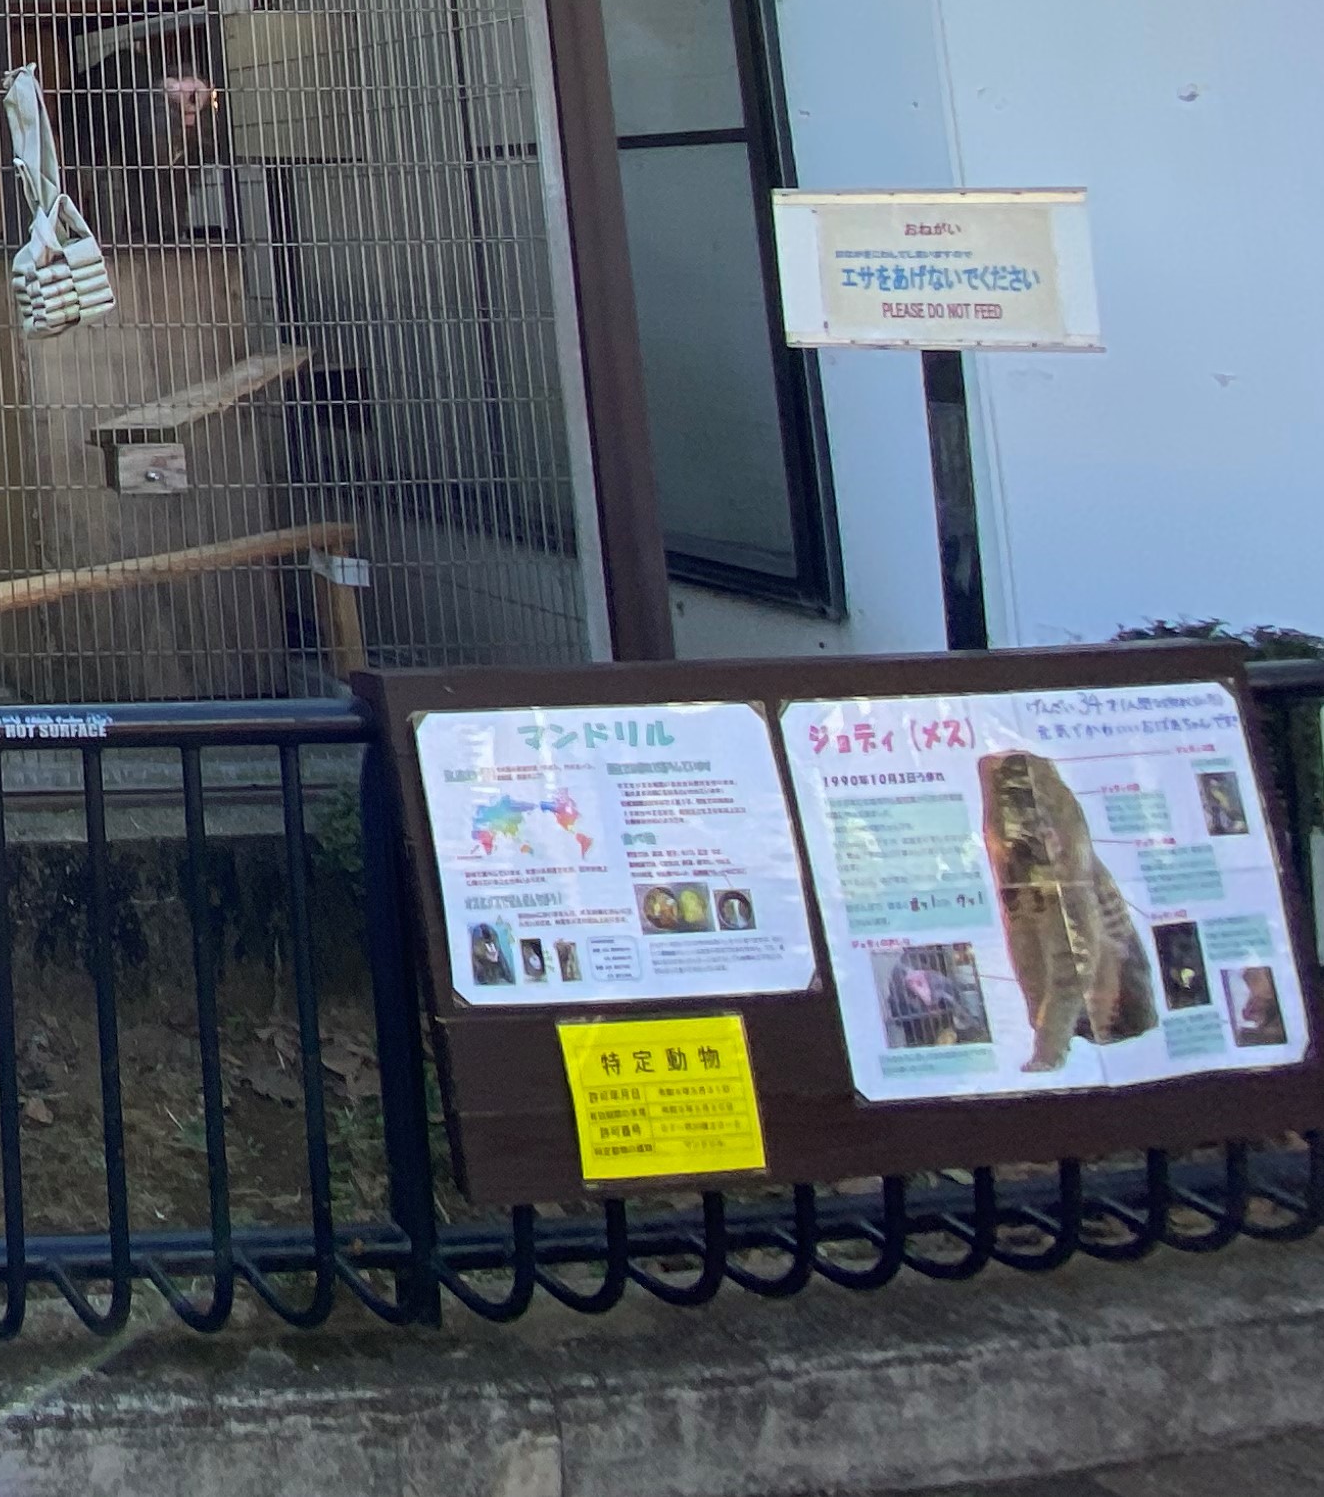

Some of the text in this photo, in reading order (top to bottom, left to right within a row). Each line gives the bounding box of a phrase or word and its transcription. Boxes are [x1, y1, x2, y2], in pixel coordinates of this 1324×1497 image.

[904, 222, 963, 237] おねがい
[840, 264, 1042, 292] エサをあげないでください
[881, 302, 1003, 319] PLEASE DO NOT FEED
[5, 723, 107, 739] HOT SURFACE
[516, 719, 676, 751] マンドリル
[600, 1045, 721, 1077] 特定動物
[588, 1088, 641, 1104] 許可年月日
[599, 1123, 642, 1140] 許可番号
